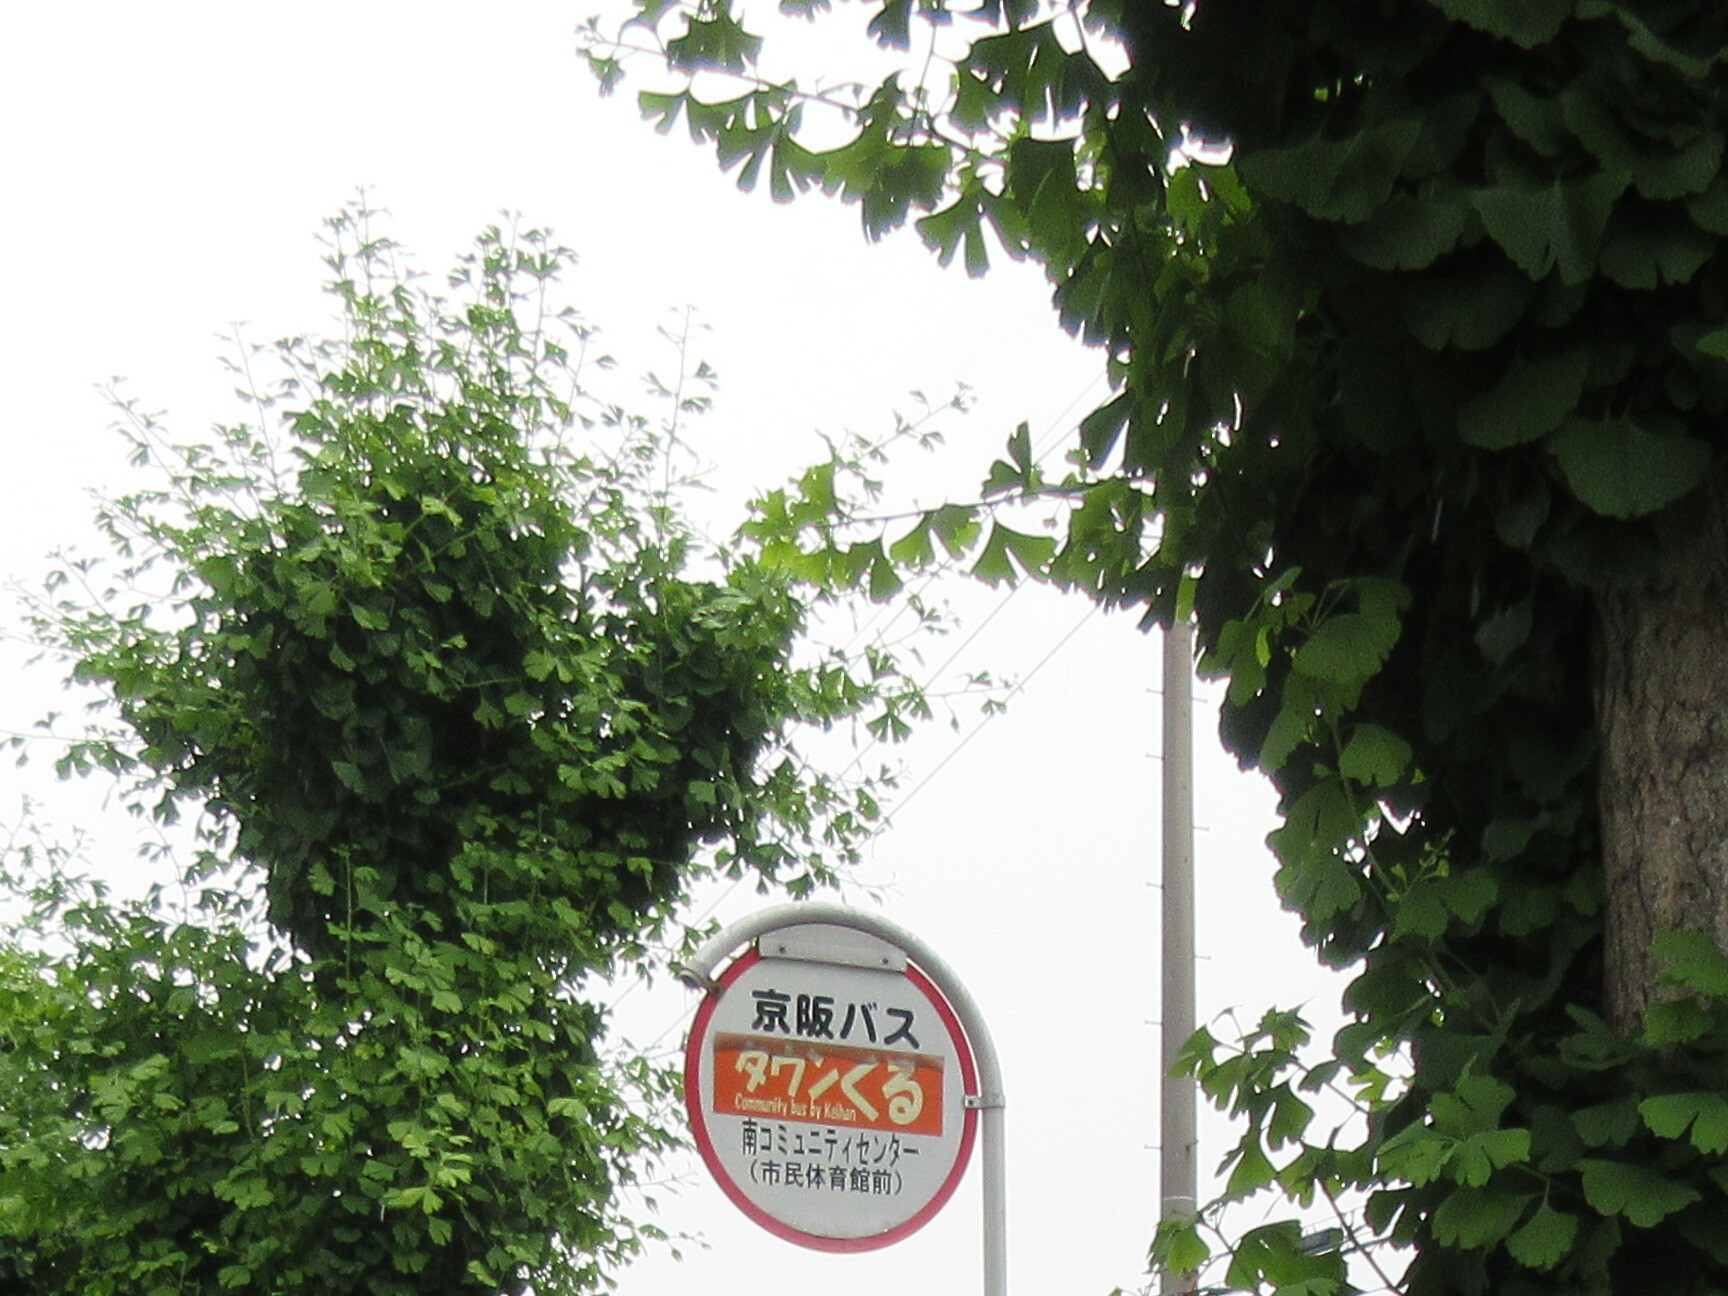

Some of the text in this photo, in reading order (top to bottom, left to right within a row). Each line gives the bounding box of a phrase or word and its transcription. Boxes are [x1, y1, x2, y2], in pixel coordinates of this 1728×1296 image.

[751, 989, 920, 1049] 京阪バス
[735, 1092, 856, 1121] Community bus by Keihan
[742, 1118, 920, 1167] 南コミュニティセンター
[749, 1159, 903, 1195] （市民体育館前）
